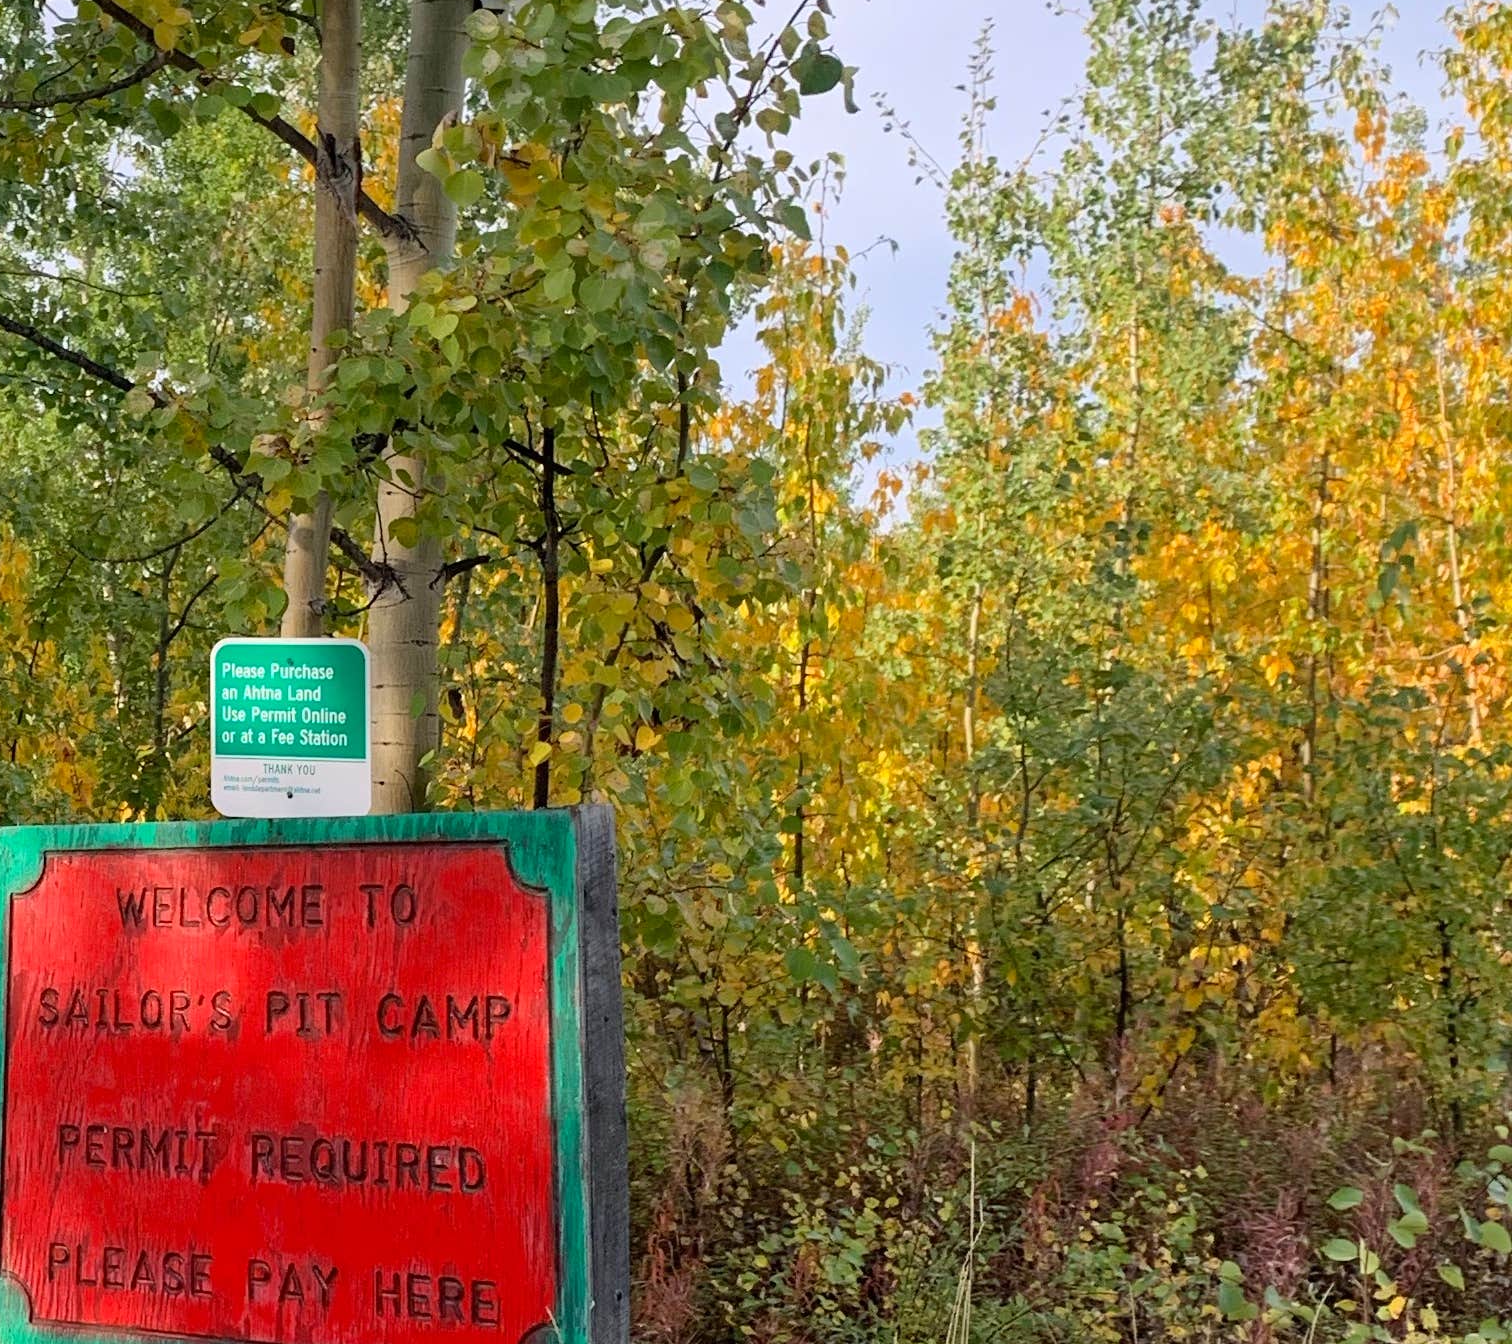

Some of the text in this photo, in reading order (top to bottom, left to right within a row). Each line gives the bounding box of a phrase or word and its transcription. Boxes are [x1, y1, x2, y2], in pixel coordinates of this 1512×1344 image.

[222, 662, 334, 681] Please Purchase
[222, 684, 321, 702] an Ahtna Land
[222, 706, 347, 725] Use Permit Online
[222, 728, 348, 747] or at a Fee Station
[263, 763, 316, 776] THANK YOU
[116, 884, 418, 929] WELCOME TO
[38, 987, 513, 1043] SAILOR'S PIT CAMP
[57, 1124, 488, 1195] PERMIT REQUIRED
[47, 1242, 502, 1329] PLEASE PAY HERE
